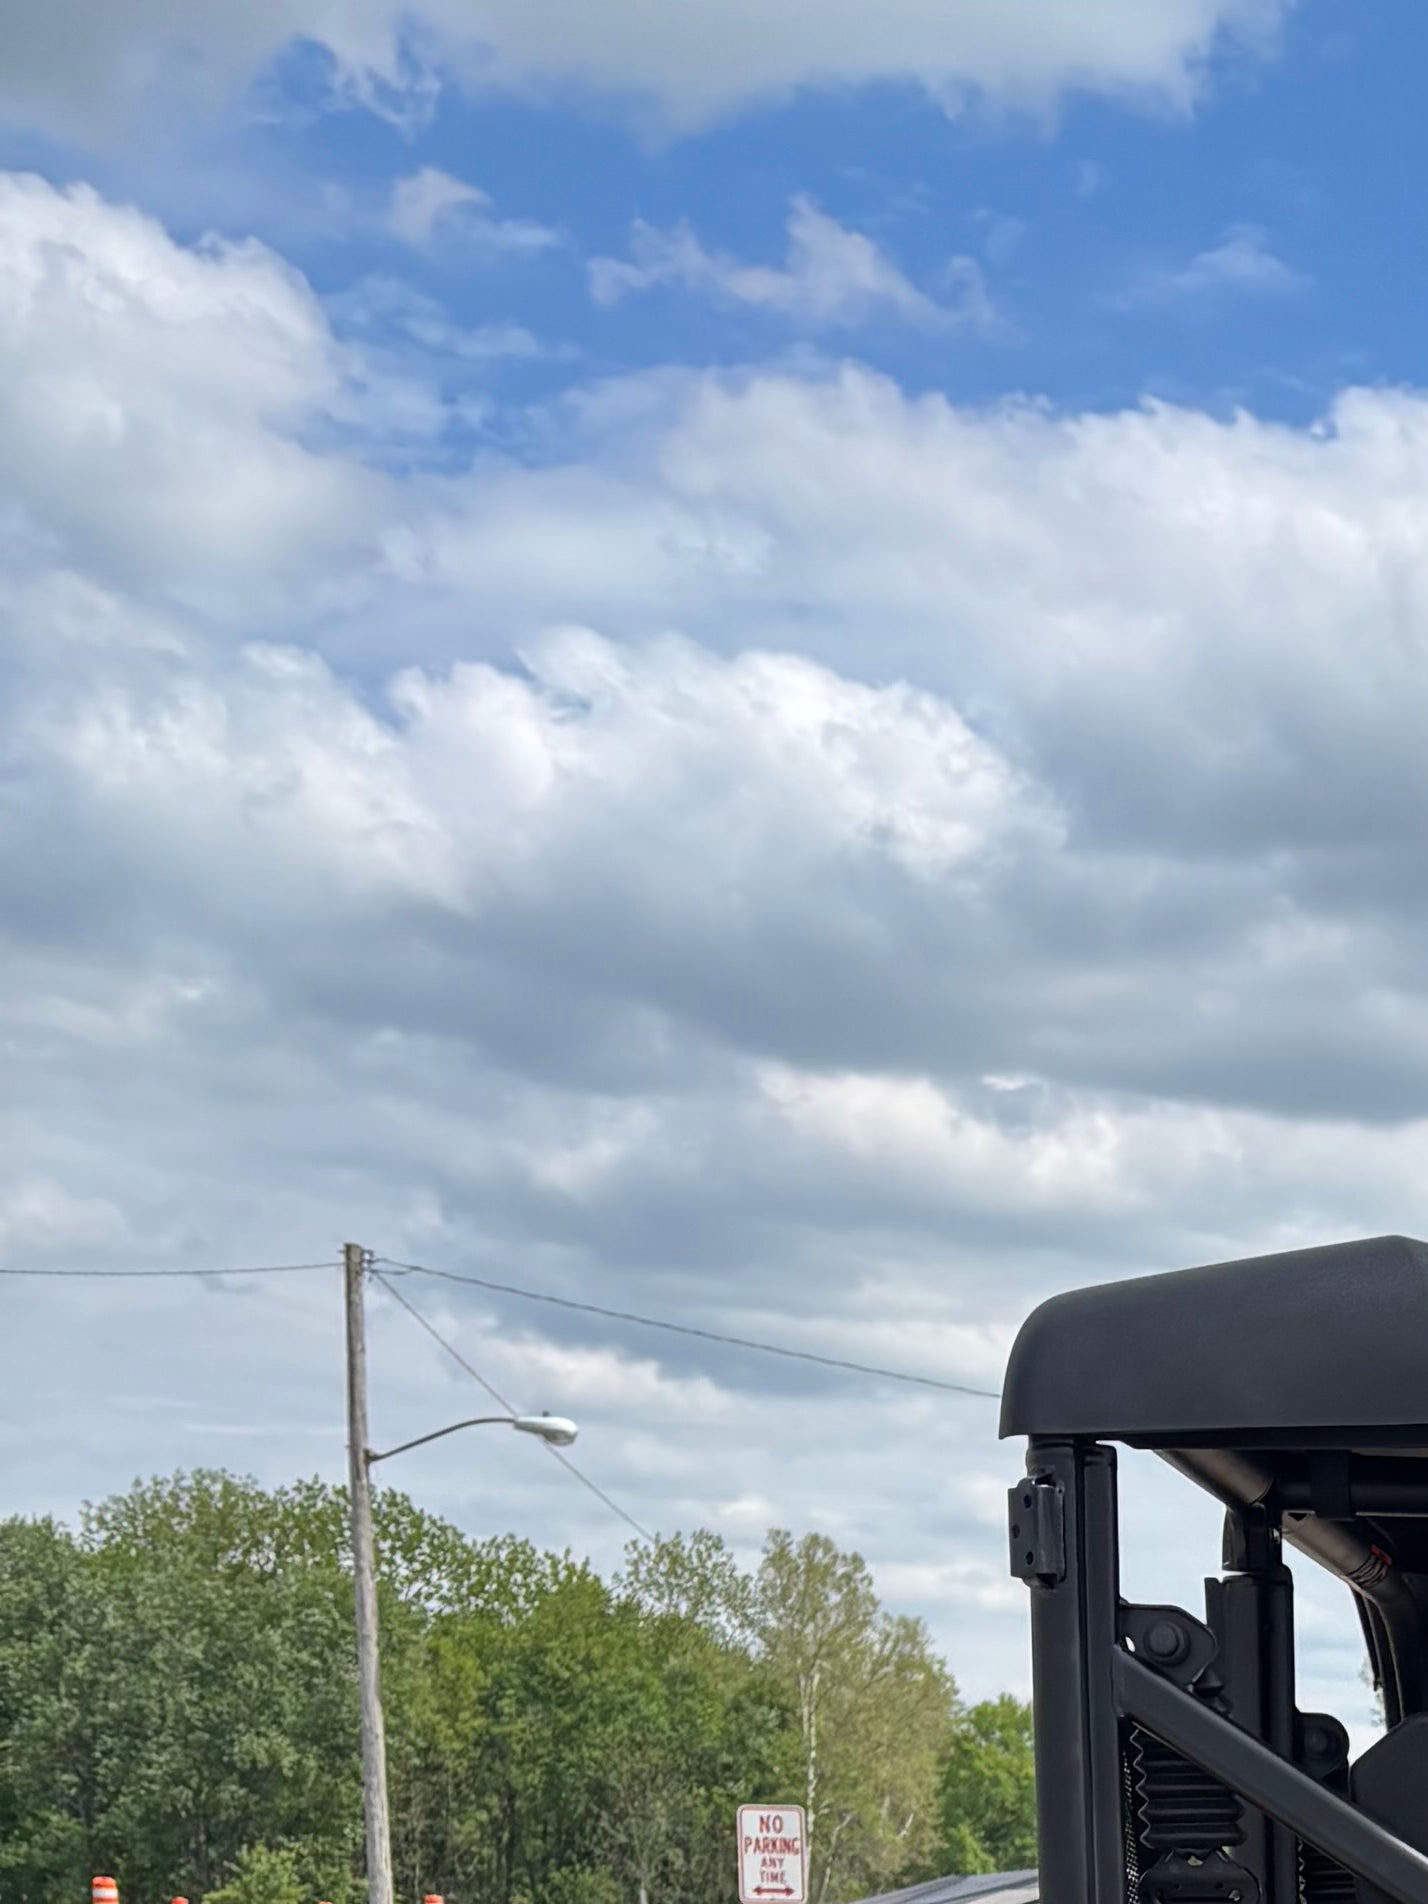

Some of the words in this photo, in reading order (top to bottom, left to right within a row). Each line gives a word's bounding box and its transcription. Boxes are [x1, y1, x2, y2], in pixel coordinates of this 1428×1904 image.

[759, 1814, 783, 1834] NO
[744, 1836, 800, 1855] PARKING
[761, 1856, 785, 1869] ANY
[760, 1870, 787, 1884] TIME
